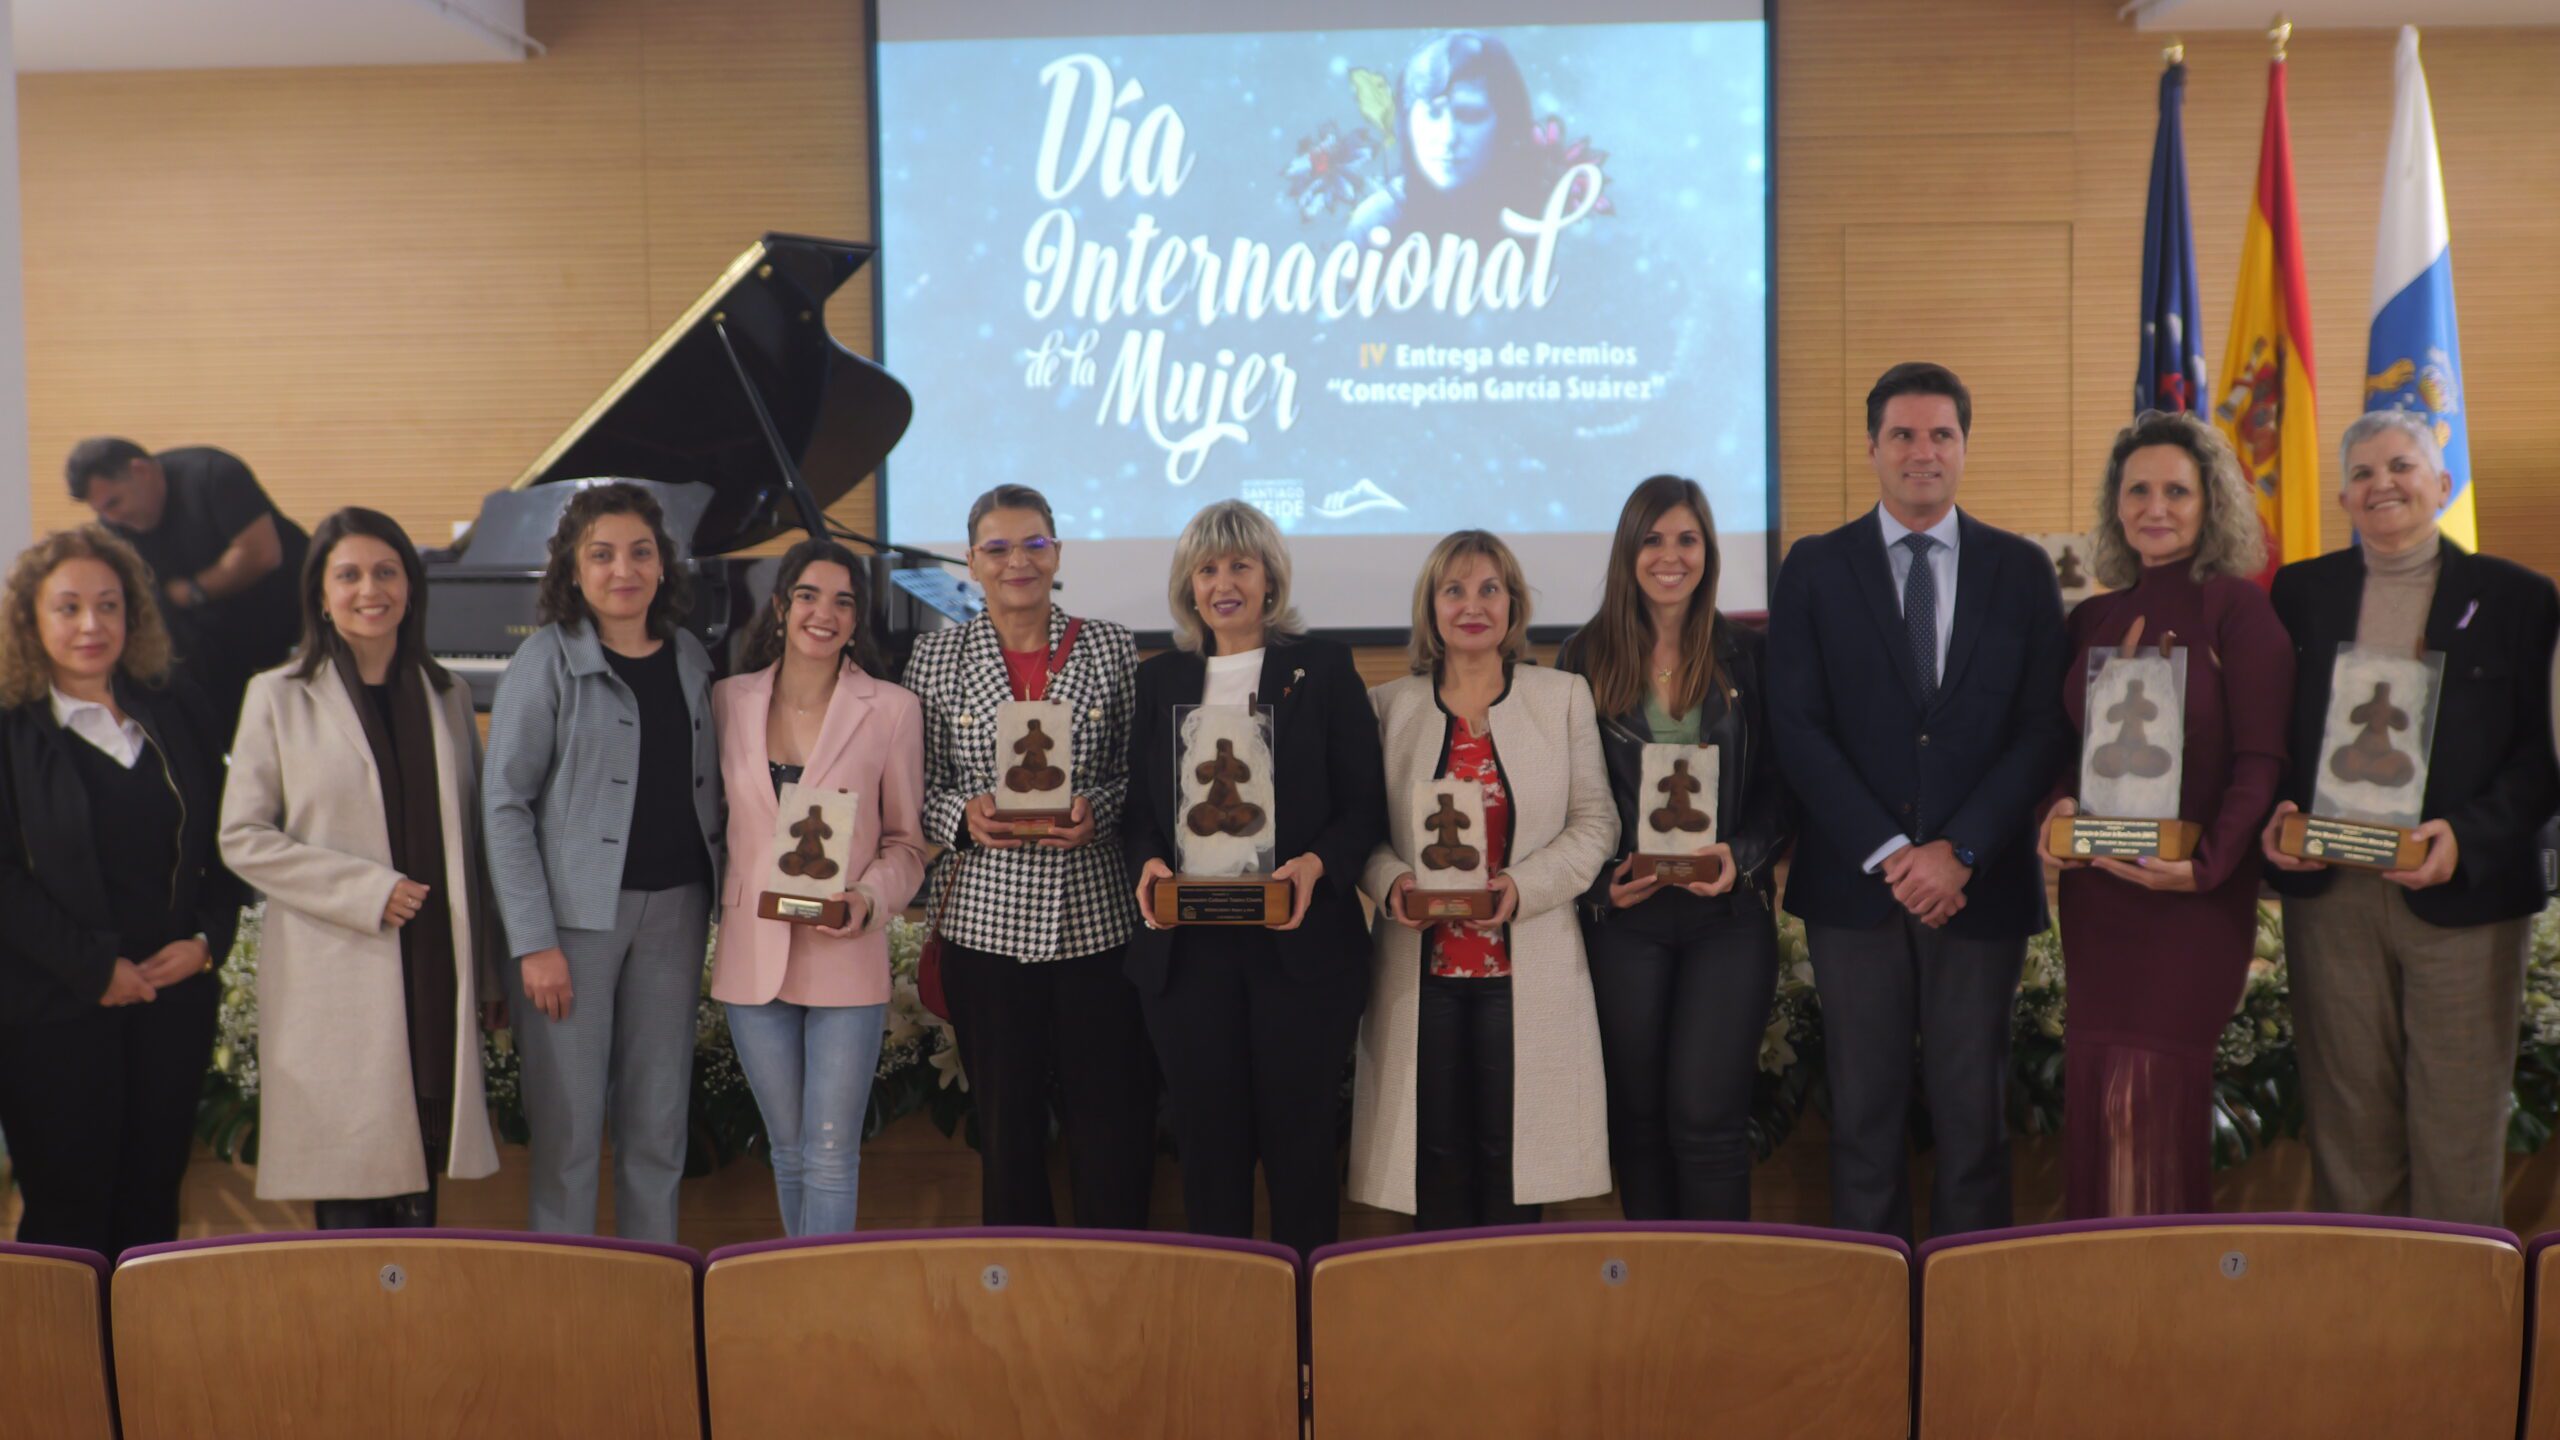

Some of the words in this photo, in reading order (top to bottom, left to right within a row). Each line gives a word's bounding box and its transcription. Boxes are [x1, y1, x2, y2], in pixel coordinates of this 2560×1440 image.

[1036, 54, 1194, 200] Día
[1024, 164, 1602, 324] Internacional
[1360, 343, 1387, 368] IV
[1396, 344, 1493, 374] Entrega
[1499, 341, 1532, 366] de
[1535, 341, 1638, 366] Premios
[1483, 375, 1560, 401] García
[1025, 329, 1063, 387] de
[1060, 328, 1099, 387] la
[1096, 329, 1299, 486] Mujer
[1241, 487, 1304, 500] SANTIAGO
[1610, 1264, 1618, 1280] 6
[2231, 1257, 2239, 1272] 7
[389, 1271, 396, 1285] 4
[992, 1271, 999, 1285] 5
